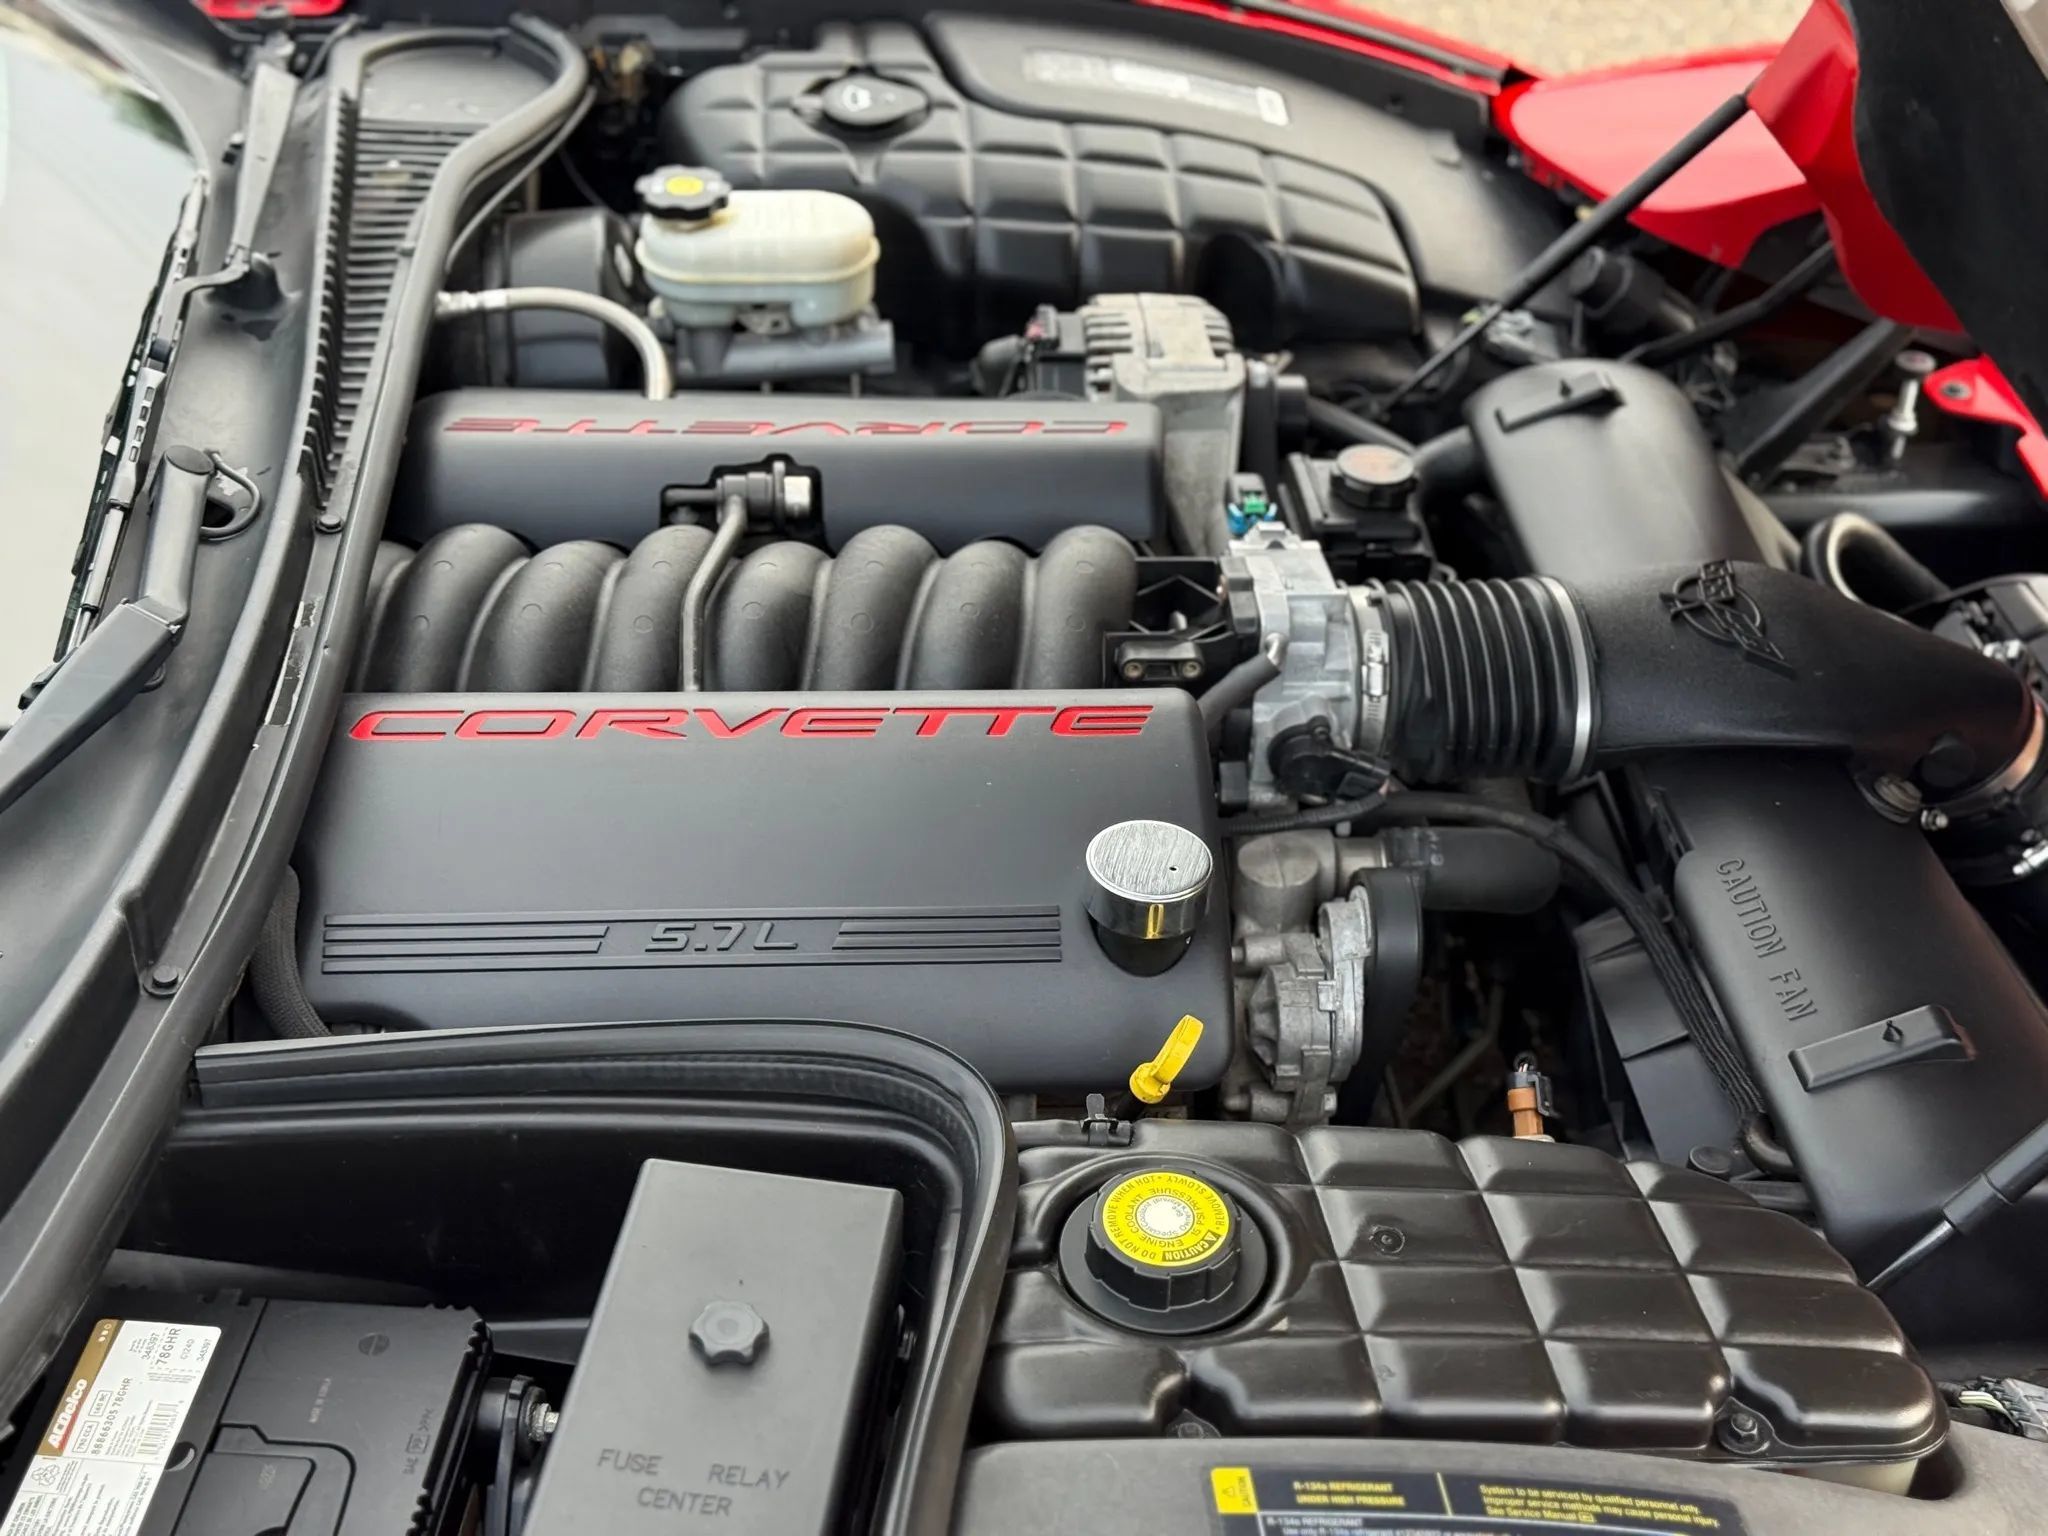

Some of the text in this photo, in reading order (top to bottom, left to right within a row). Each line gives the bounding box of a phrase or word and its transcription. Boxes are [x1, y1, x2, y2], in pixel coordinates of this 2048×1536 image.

[444, 418, 1128, 435] CORVETTE
[349, 705, 1154, 741] CORVETTE
[645, 922, 798, 953] 5.7L
[1716, 857, 1818, 1022] CAUTION FAN
[1148, 1187, 1201, 1211] PRESSURE
[1166, 1176, 1225, 1226] REMOVE SLOWLY
[1107, 1175, 1156, 1259] DO NOT REMOVE WHEN HOT
[1125, 1193, 1184, 1248] ENGINE COOLANT
[1196, 1212, 1205, 1225] PSI
[1165, 1241, 1209, 1260] CAUTION
[155, 1328, 182, 1365] 78GHR
[112, 1377, 133, 1407] 78GHR
[597, 1448, 663, 1475] FUSE
[708, 1463, 790, 1489] RELAY
[1329, 1482, 1392, 1492] REFRIGERANT
[637, 1487, 733, 1516] CENTER
[1296, 1494, 1405, 1506] UNDER HIGH PRESSURE
[1480, 1484, 1514, 1496] System
[1517, 1487, 1526, 1496] to
[1527, 1487, 1540, 1497] be
[1542, 1488, 1580, 1500] serviced
[1581, 1492, 1593, 1503] by
[1594, 1494, 1633, 1506] qualified
[1635, 1498, 1679, 1511] personnel
[1483, 1496, 1525, 1508] Improper
[1527, 1499, 1560, 1509] service
[1562, 1501, 1602, 1512] methods
[1603, 1505, 1623, 1516] may
[1625, 1508, 1651, 1518] cause
[1653, 1511, 1691, 1523] personal
[1486, 1505, 1576, 1520] See Service Manual
